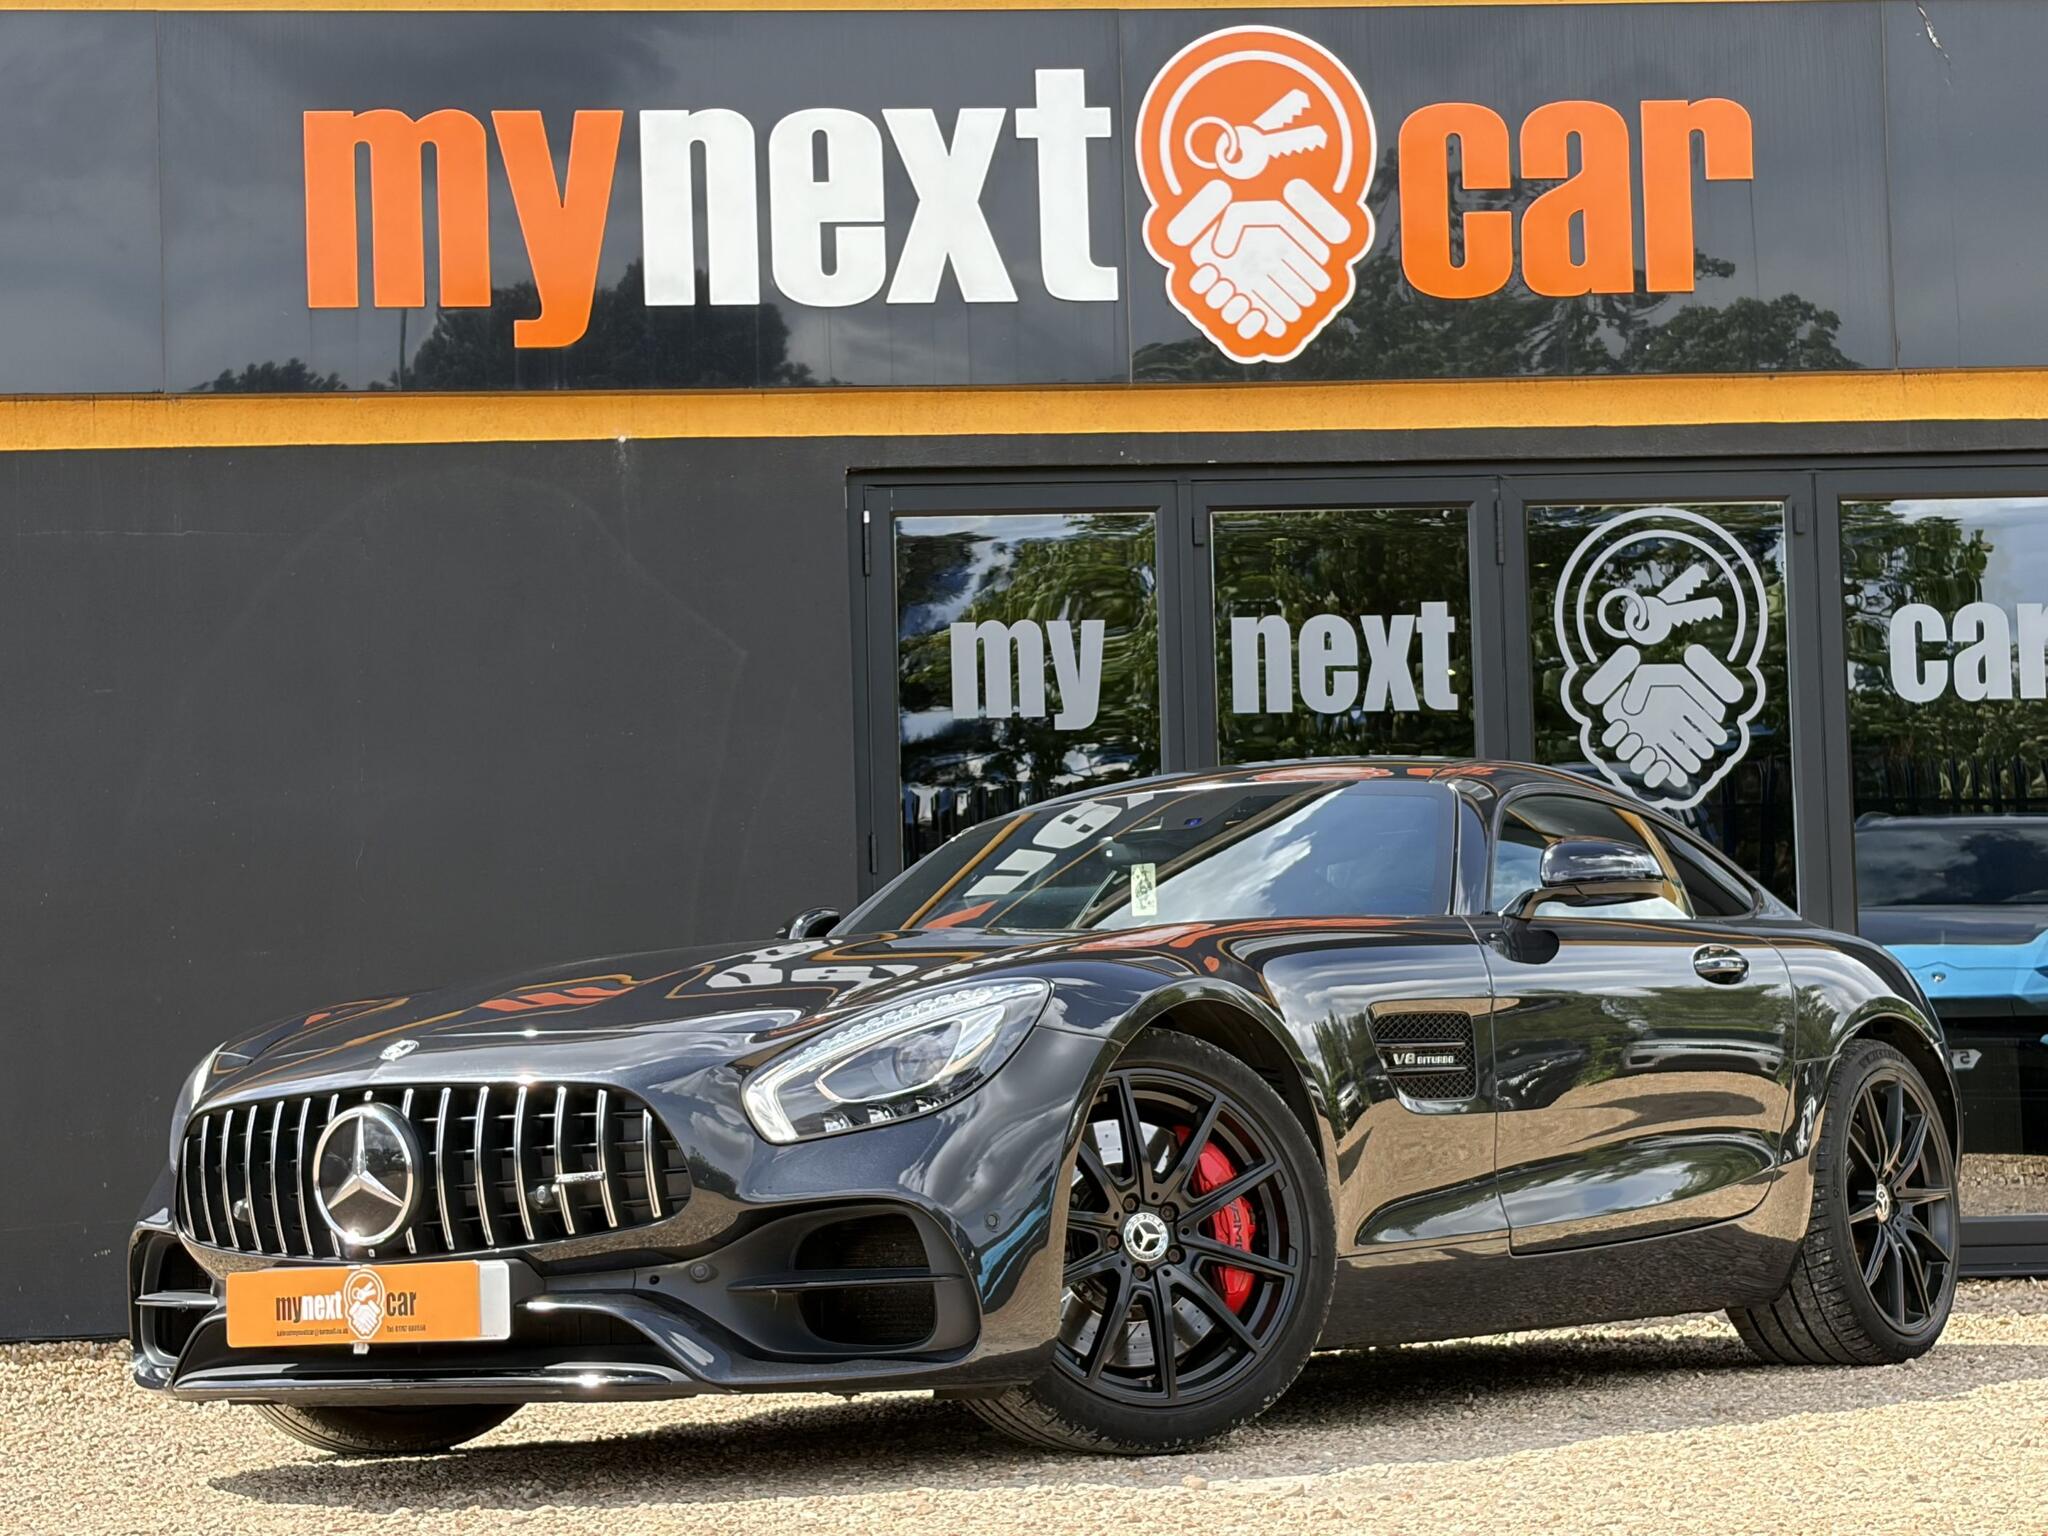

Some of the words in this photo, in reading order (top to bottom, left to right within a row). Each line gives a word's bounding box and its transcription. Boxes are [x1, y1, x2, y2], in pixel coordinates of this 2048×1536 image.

[1398, 97, 1754, 299] car
[950, 618, 1106, 731] my
[1230, 601, 1458, 714] next
[1889, 601, 2048, 704] car
[1393, 1053, 1416, 1066] V8
[1417, 1055, 1455, 1065] BITURBO
[386, 1291, 417, 1317] car
